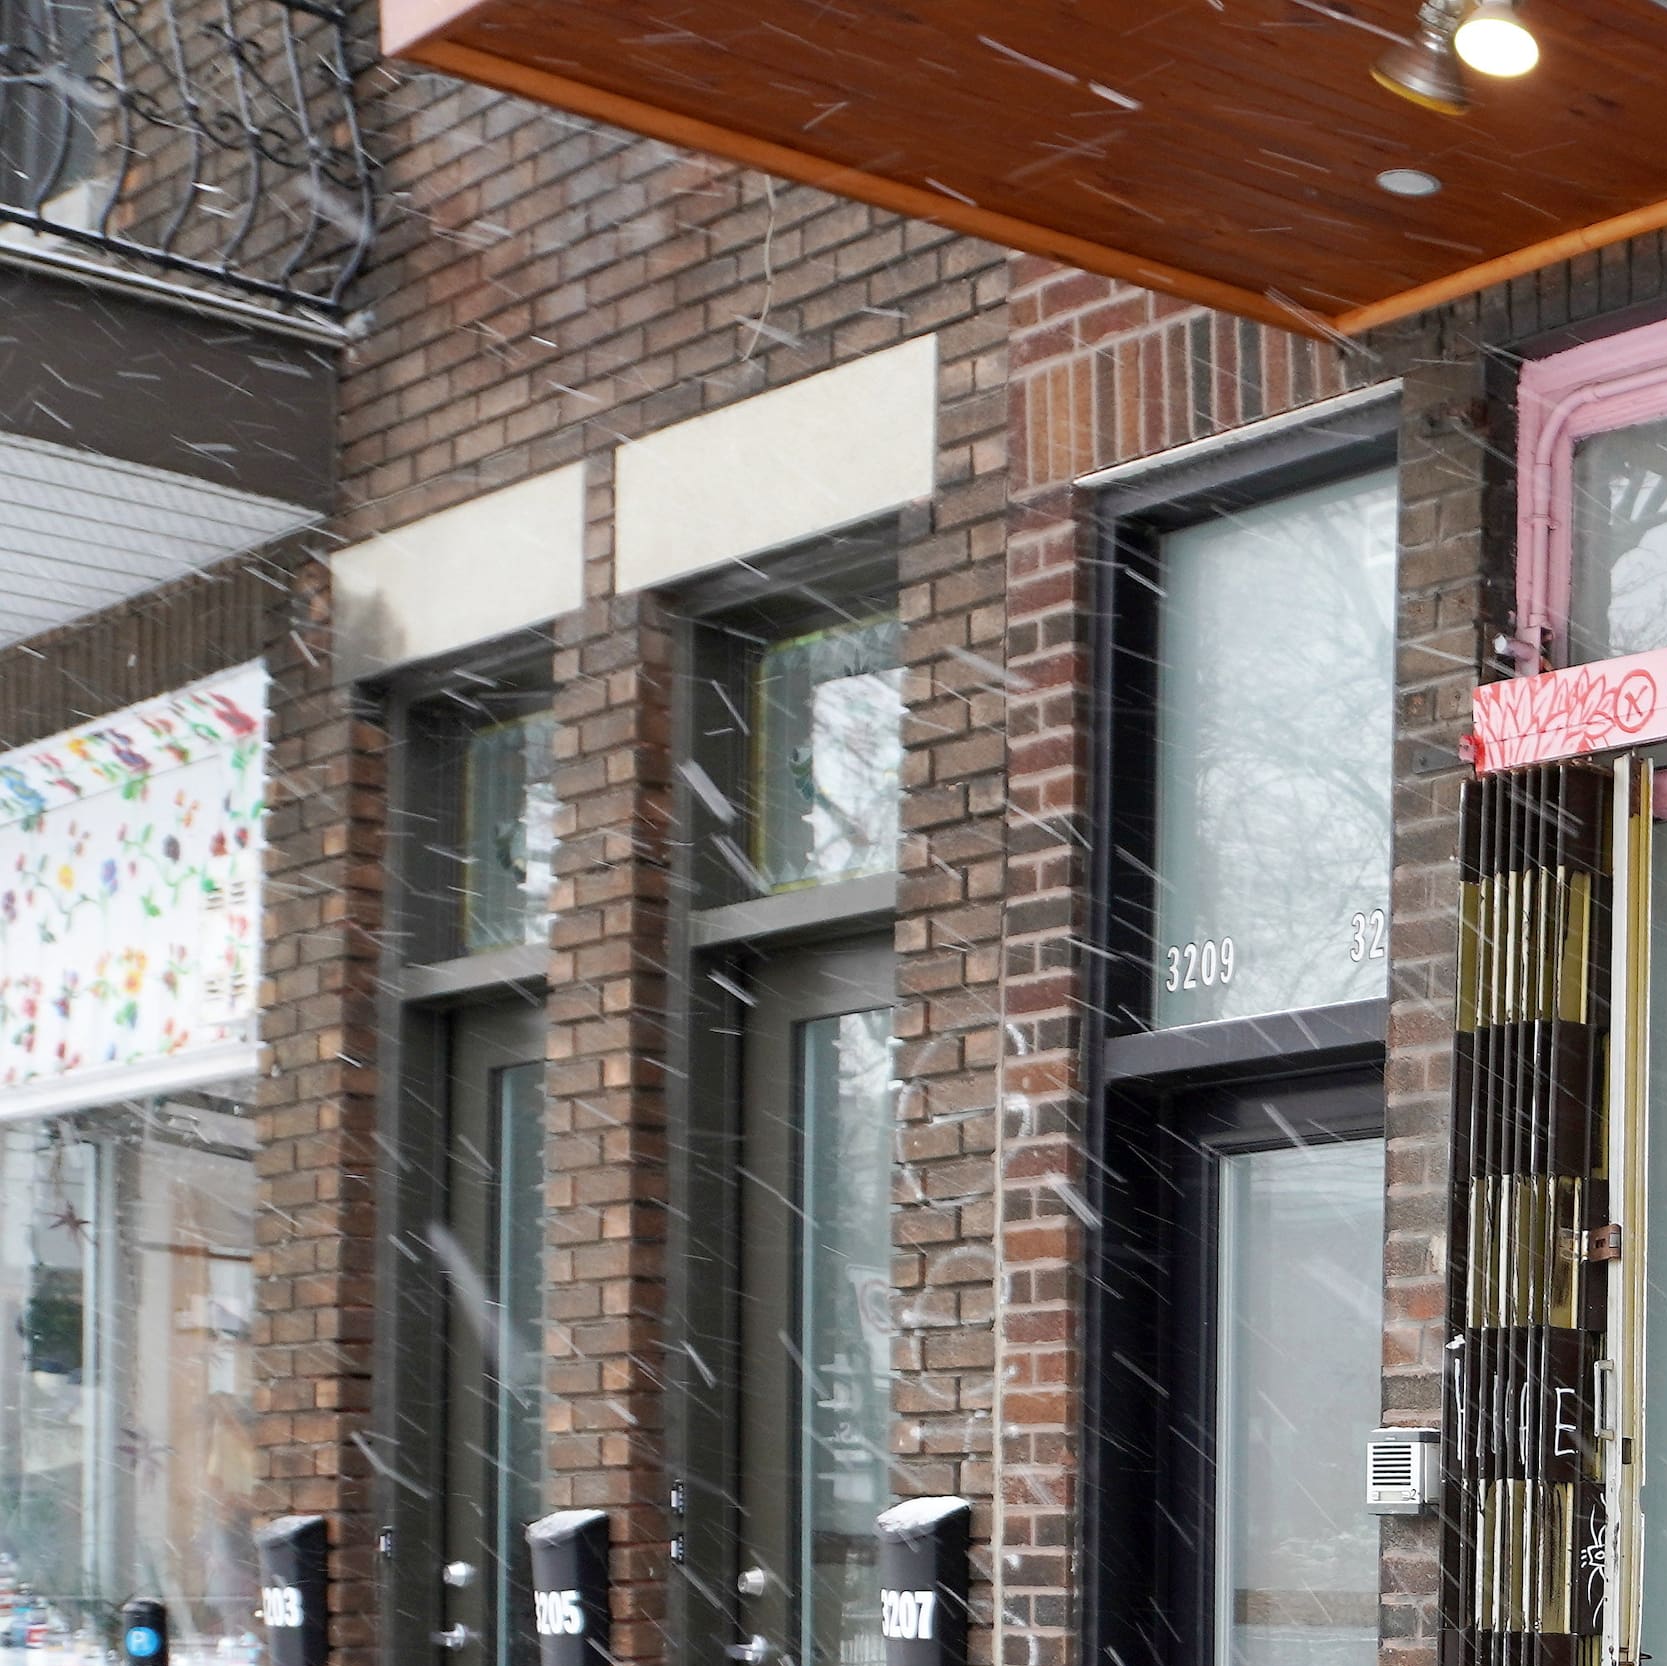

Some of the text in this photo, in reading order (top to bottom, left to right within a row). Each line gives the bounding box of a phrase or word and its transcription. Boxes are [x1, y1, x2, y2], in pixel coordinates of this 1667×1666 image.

[1166, 936, 1235, 992] 3209
[263, 1586, 305, 1628] 203
[881, 1588, 936, 1640] 3207
